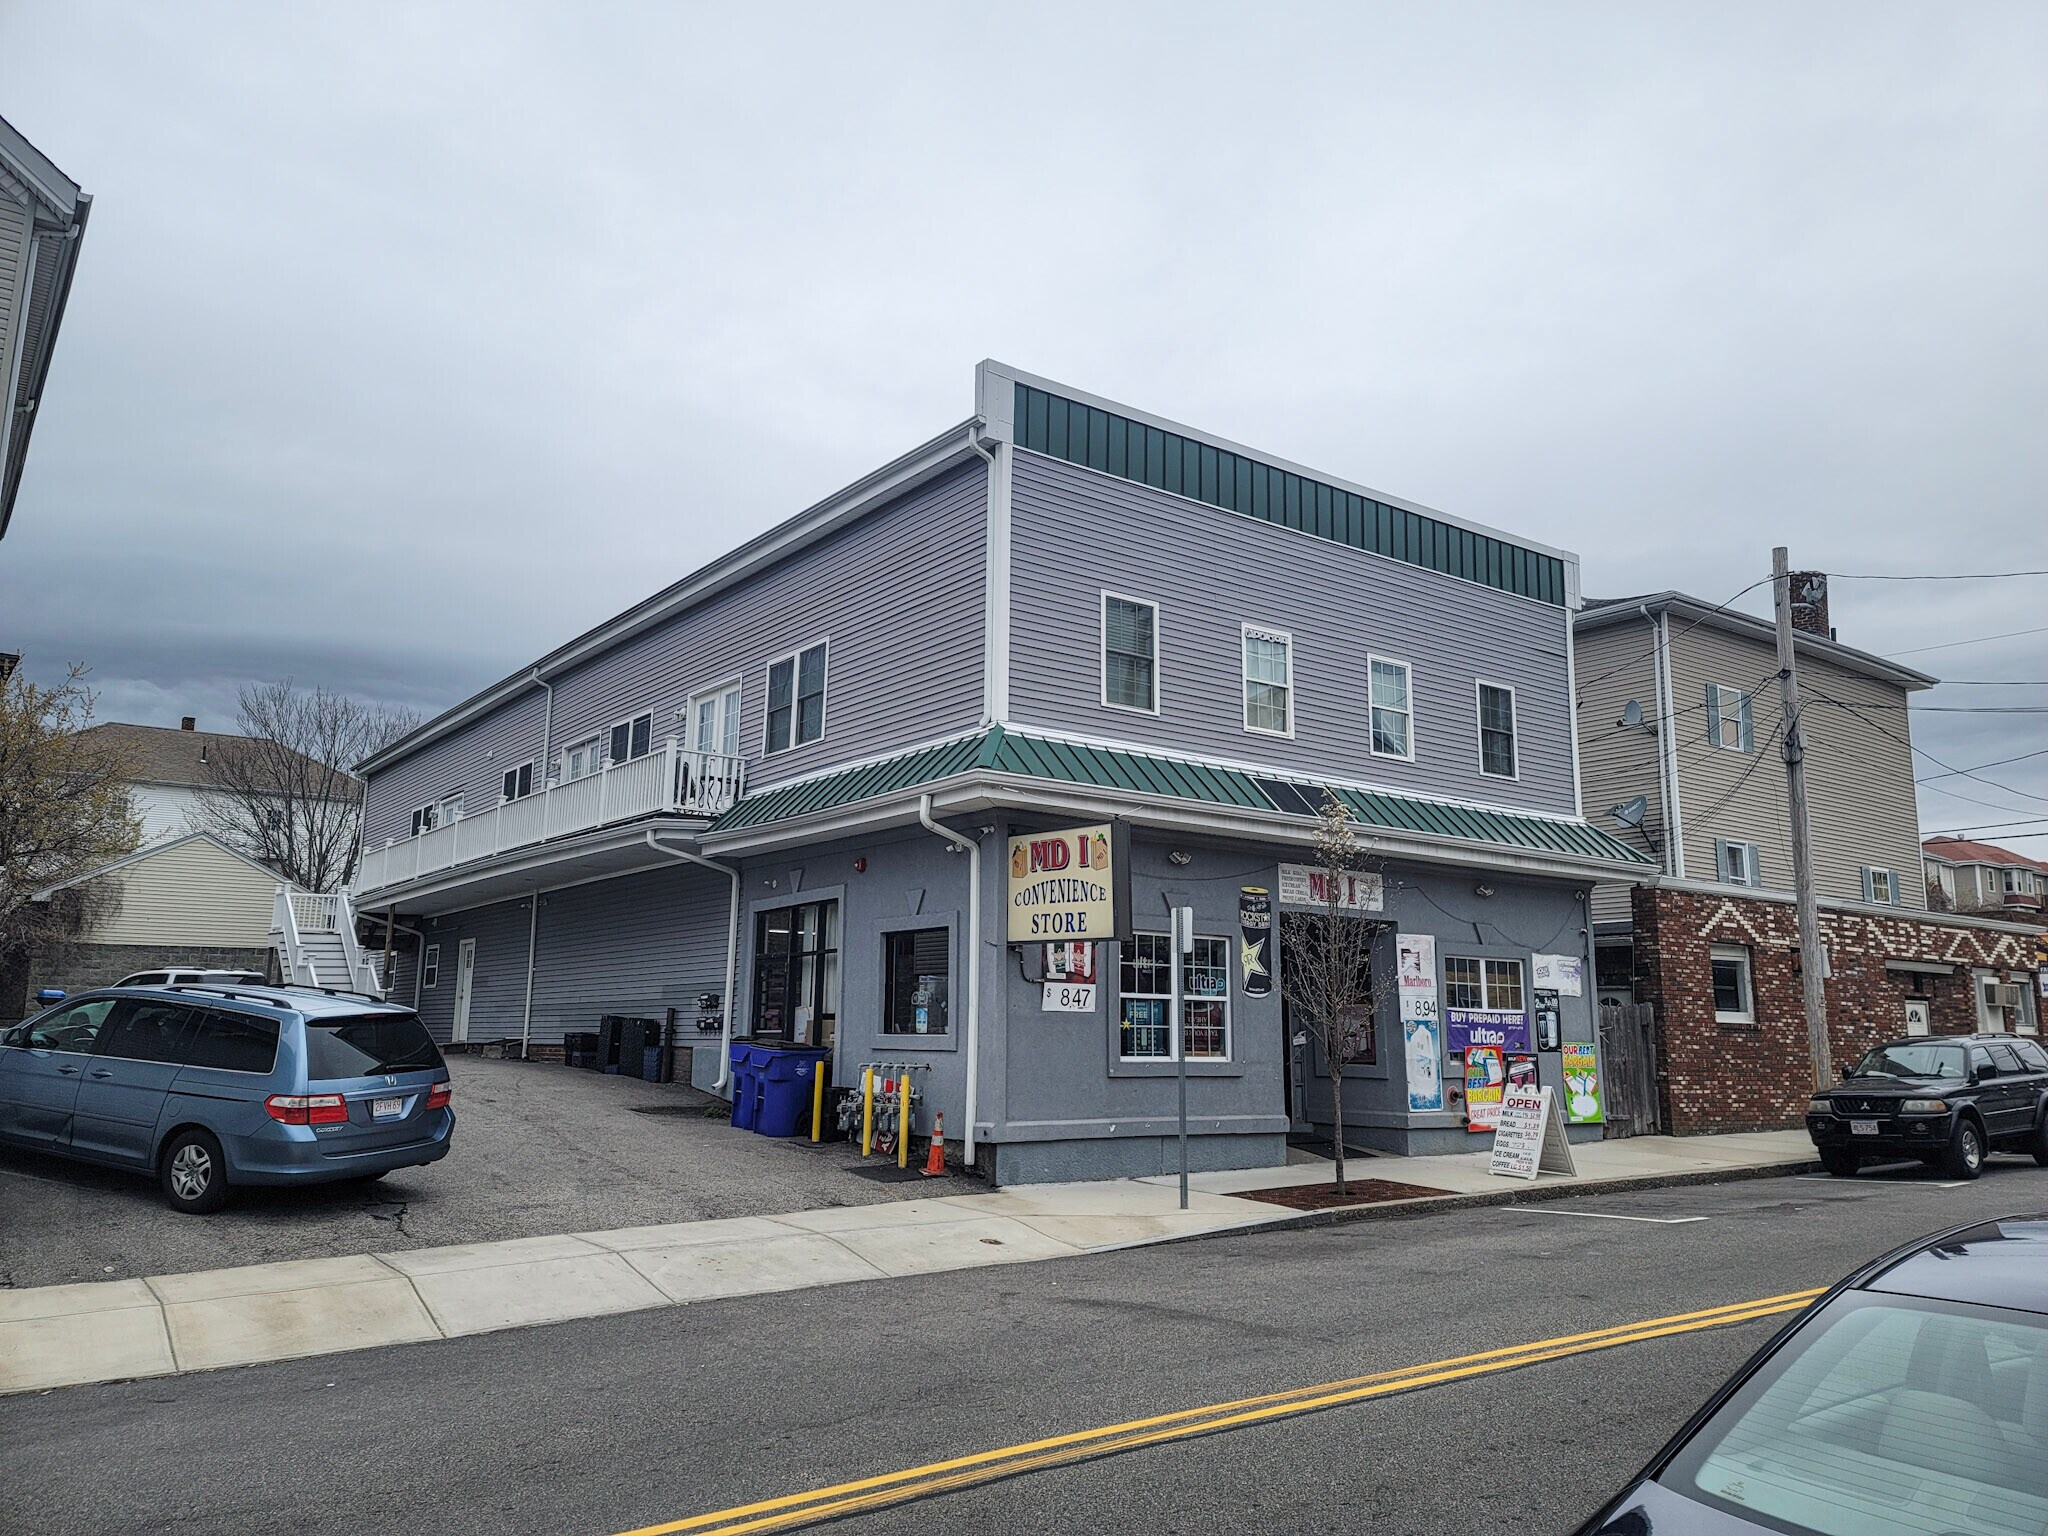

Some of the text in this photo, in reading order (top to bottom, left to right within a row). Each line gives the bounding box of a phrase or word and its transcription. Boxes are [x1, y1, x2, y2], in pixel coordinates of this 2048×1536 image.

[1030, 834, 1089, 872] MD I
[1014, 878, 1107, 906] CONVENIENCE
[1031, 911, 1087, 934] STORE
[1403, 974, 1432, 988] Marlboro
[1450, 1011, 1524, 1025] BUY PREPAID HERE!
[1563, 1044, 1595, 1056] OUR BEST
[1563, 1055, 1596, 1068] BARGAIN
[1467, 1066, 1485, 1078] OUR
[1467, 1077, 1488, 1090] BEST
[1467, 1089, 1501, 1104] BARGAIN
[375, 1099, 401, 1112] 2FVH 69
[1507, 1098, 1541, 1110] OPEN
[1471, 1108, 1486, 1120] GREAT
[1500, 1120, 1517, 1128] BREAD
[1498, 1130, 1523, 1140] CIGARETTES
[1496, 1140, 1510, 1148] EGGS
[1494, 1150, 1503, 1158] ICE
[1502, 1151, 1520, 1159] CREAM
[1492, 1160, 1510, 1168] COFFEE
